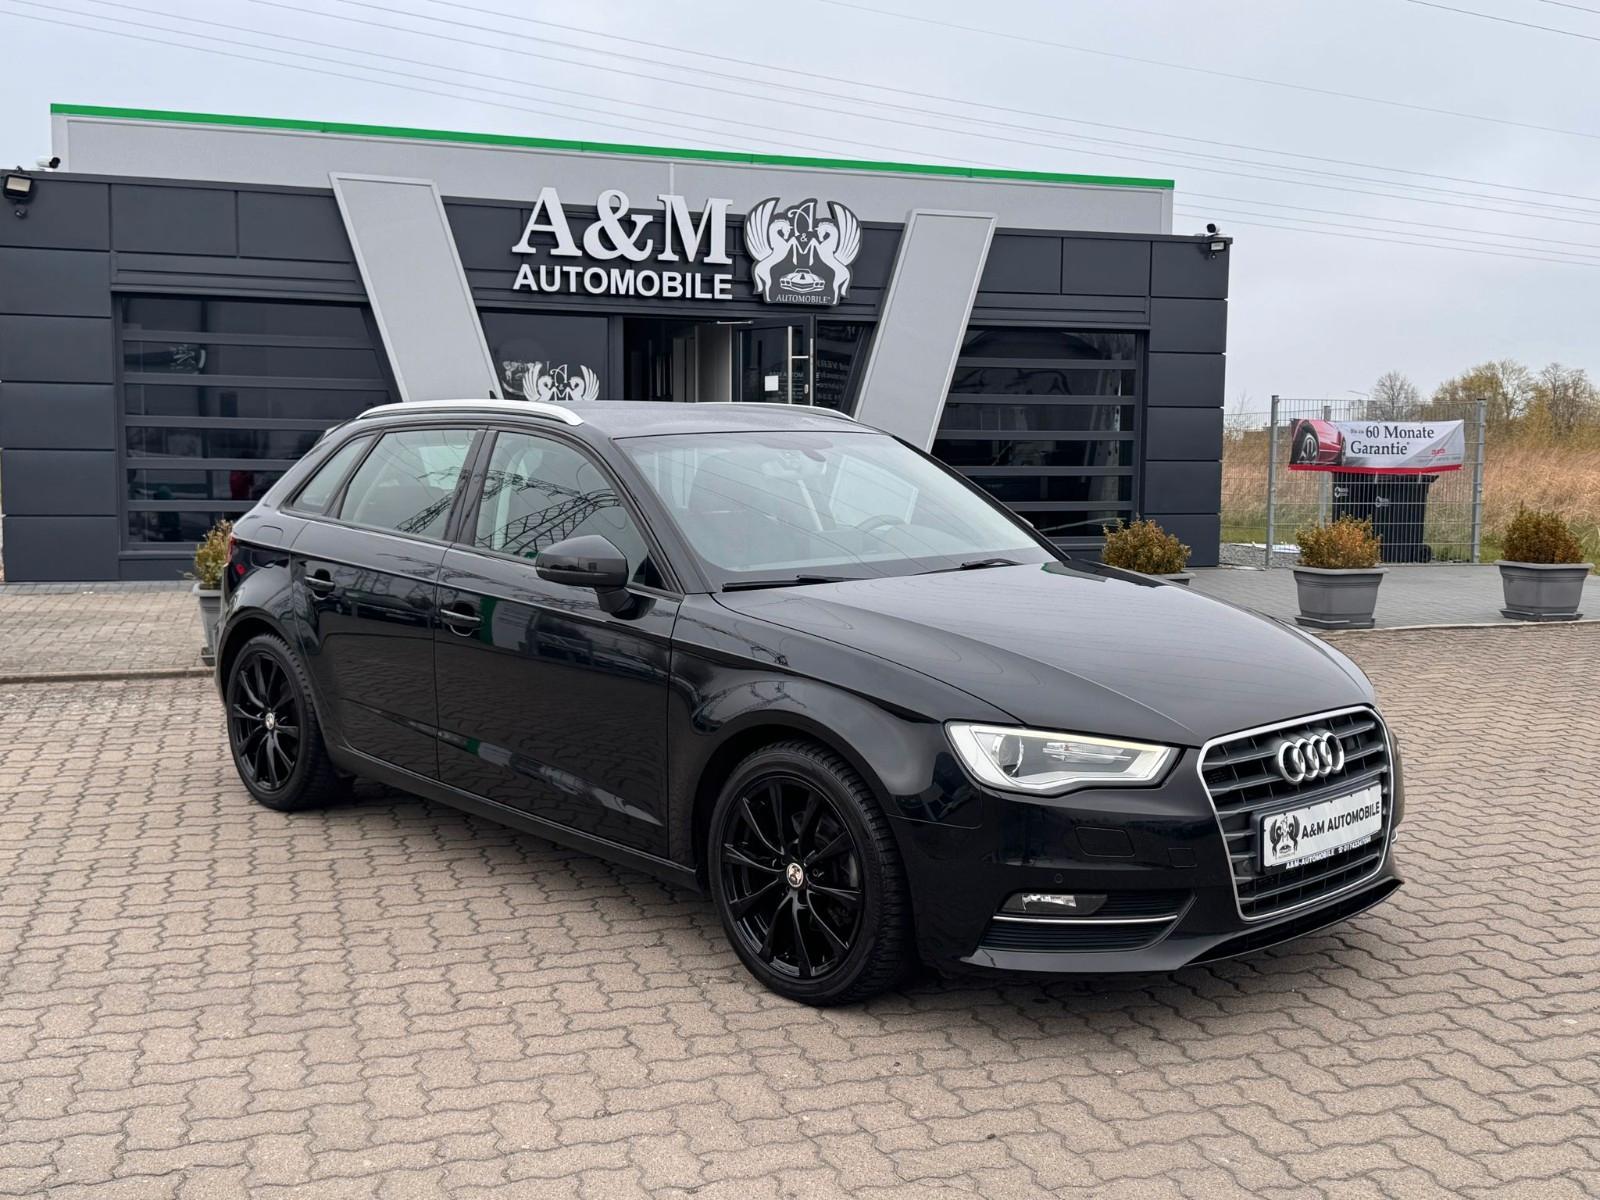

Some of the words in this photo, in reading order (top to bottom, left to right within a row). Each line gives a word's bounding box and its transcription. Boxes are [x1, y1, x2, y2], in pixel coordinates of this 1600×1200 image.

[511, 186, 734, 265] A&M
[512, 263, 733, 300] AUTOMOBILE
[1366, 425, 1380, 439] 60
[1383, 425, 1435, 439] Monate
[1301, 819, 1325, 840] A&M
[1327, 801, 1380, 832] AUTOMOBILE
